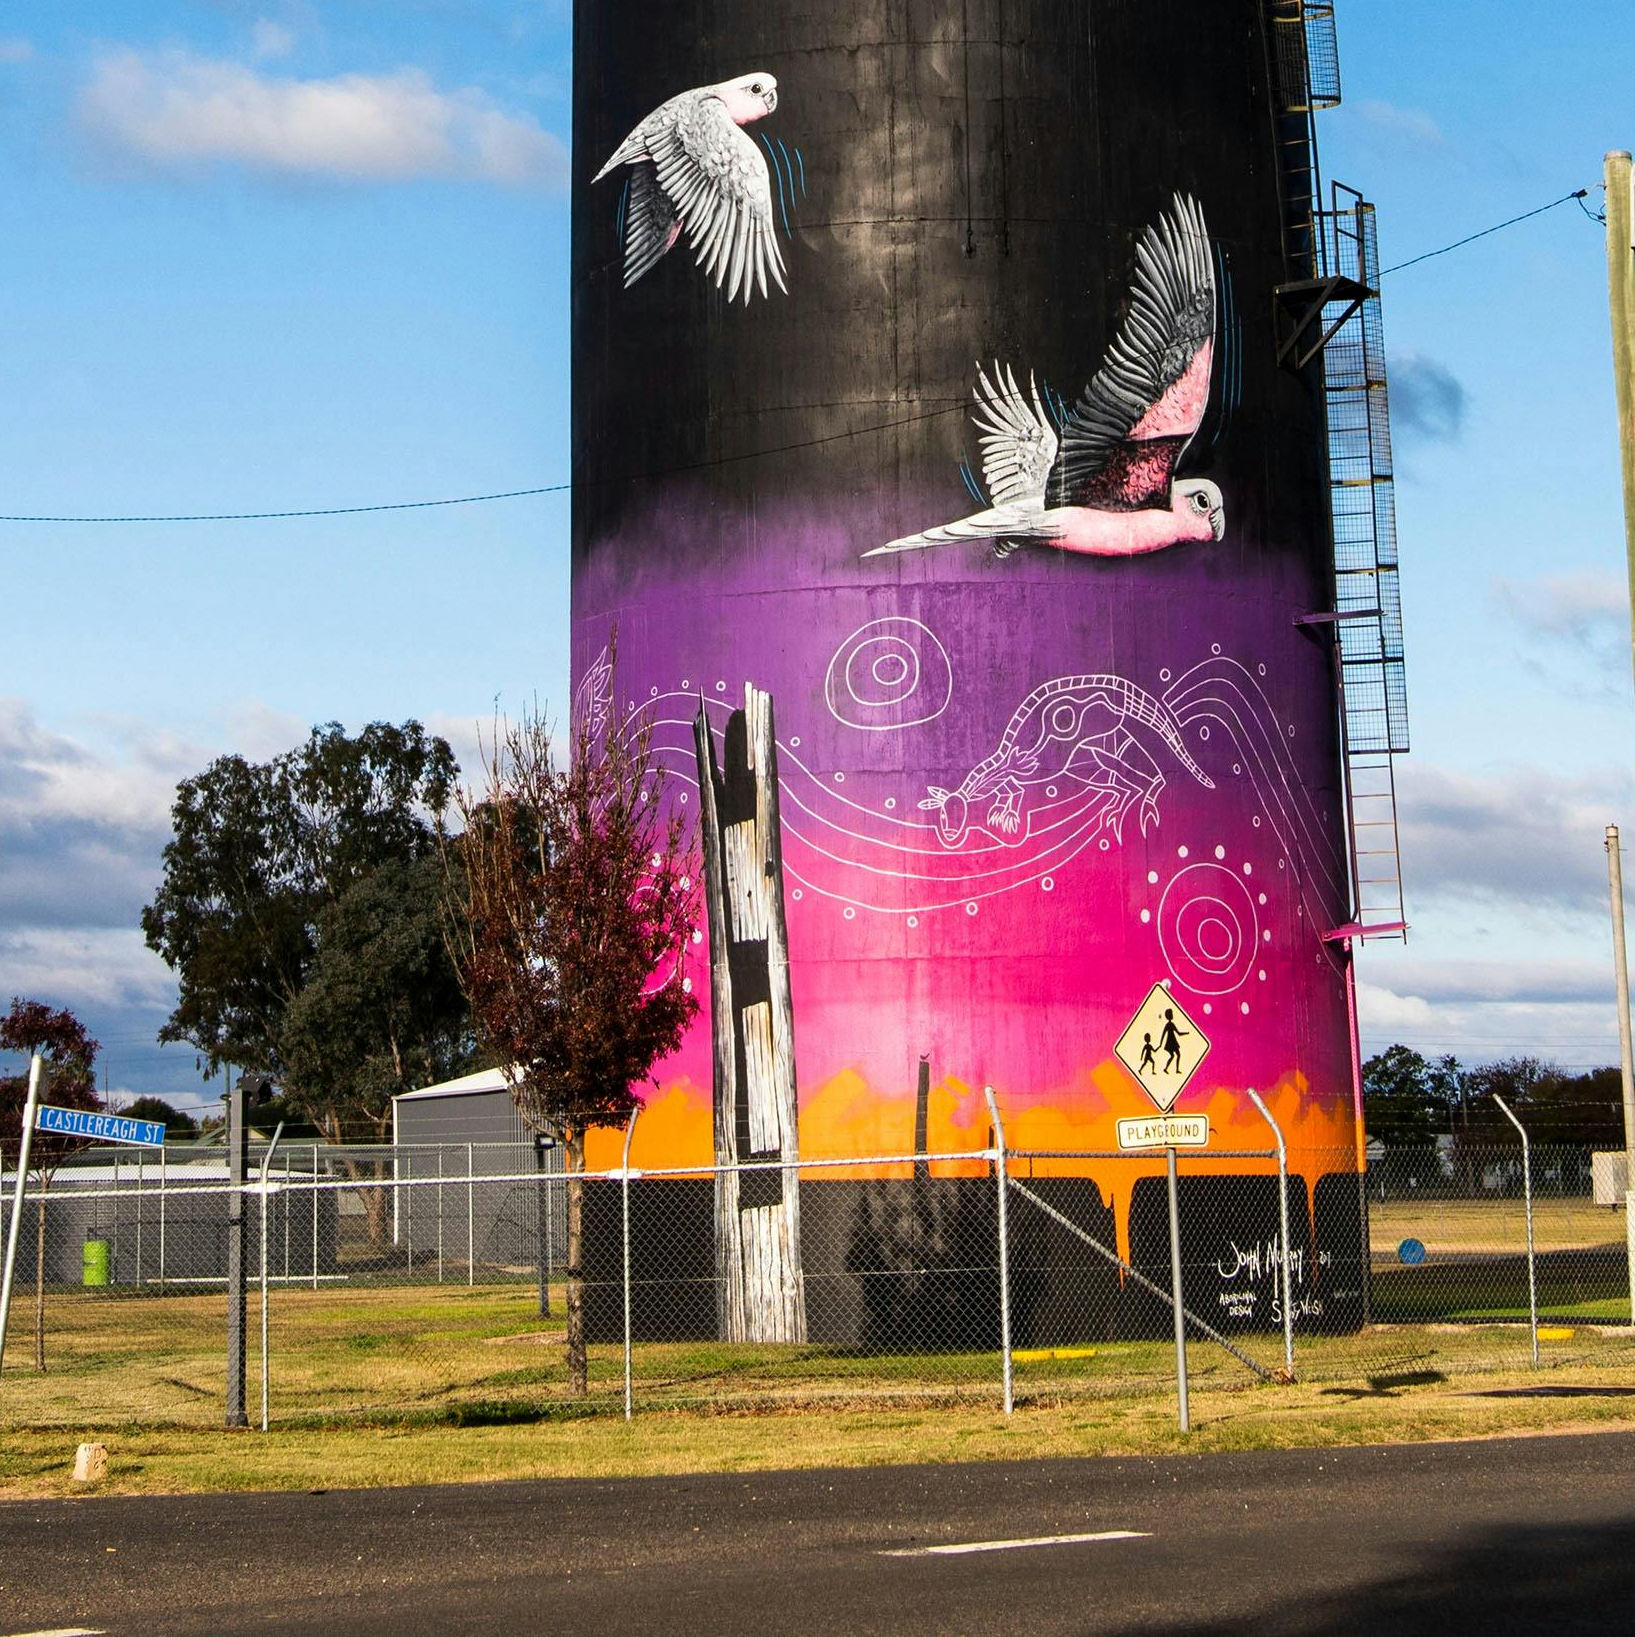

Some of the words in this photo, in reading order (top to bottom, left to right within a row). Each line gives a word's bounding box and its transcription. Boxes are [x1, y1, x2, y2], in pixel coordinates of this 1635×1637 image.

[47, 1109, 138, 1140] CASTLEREAGH
[144, 1123, 160, 1143] ST
[1127, 1124, 1199, 1140] PLAYGROUND
[1218, 1240, 1262, 1281] JOHN
